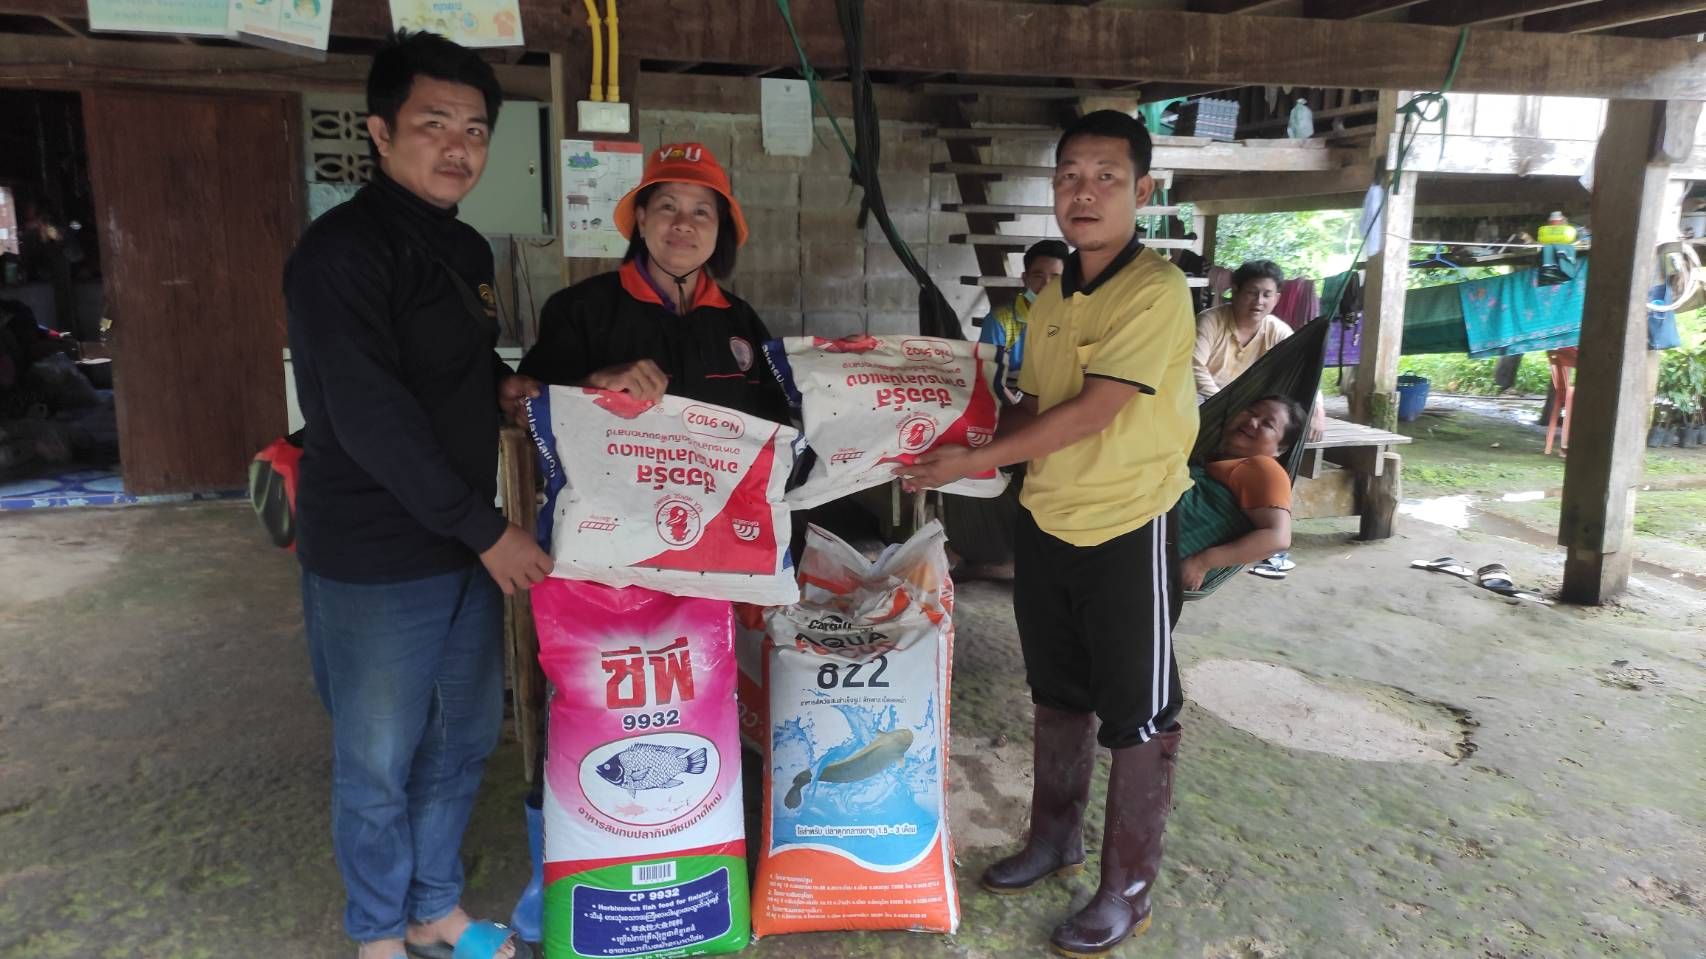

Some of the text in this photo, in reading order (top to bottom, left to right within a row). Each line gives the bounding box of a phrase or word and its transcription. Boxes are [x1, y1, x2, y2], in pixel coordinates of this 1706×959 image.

[687, 411, 741, 434] No 9102
[636, 463, 718, 495] ซีฮอร์ส
[816, 654, 890, 690] 822
[623, 710, 680, 730] 9932
[629, 887, 680, 902] CP 9932
[642, 903, 657, 911] fish
[658, 900, 675, 909] food
